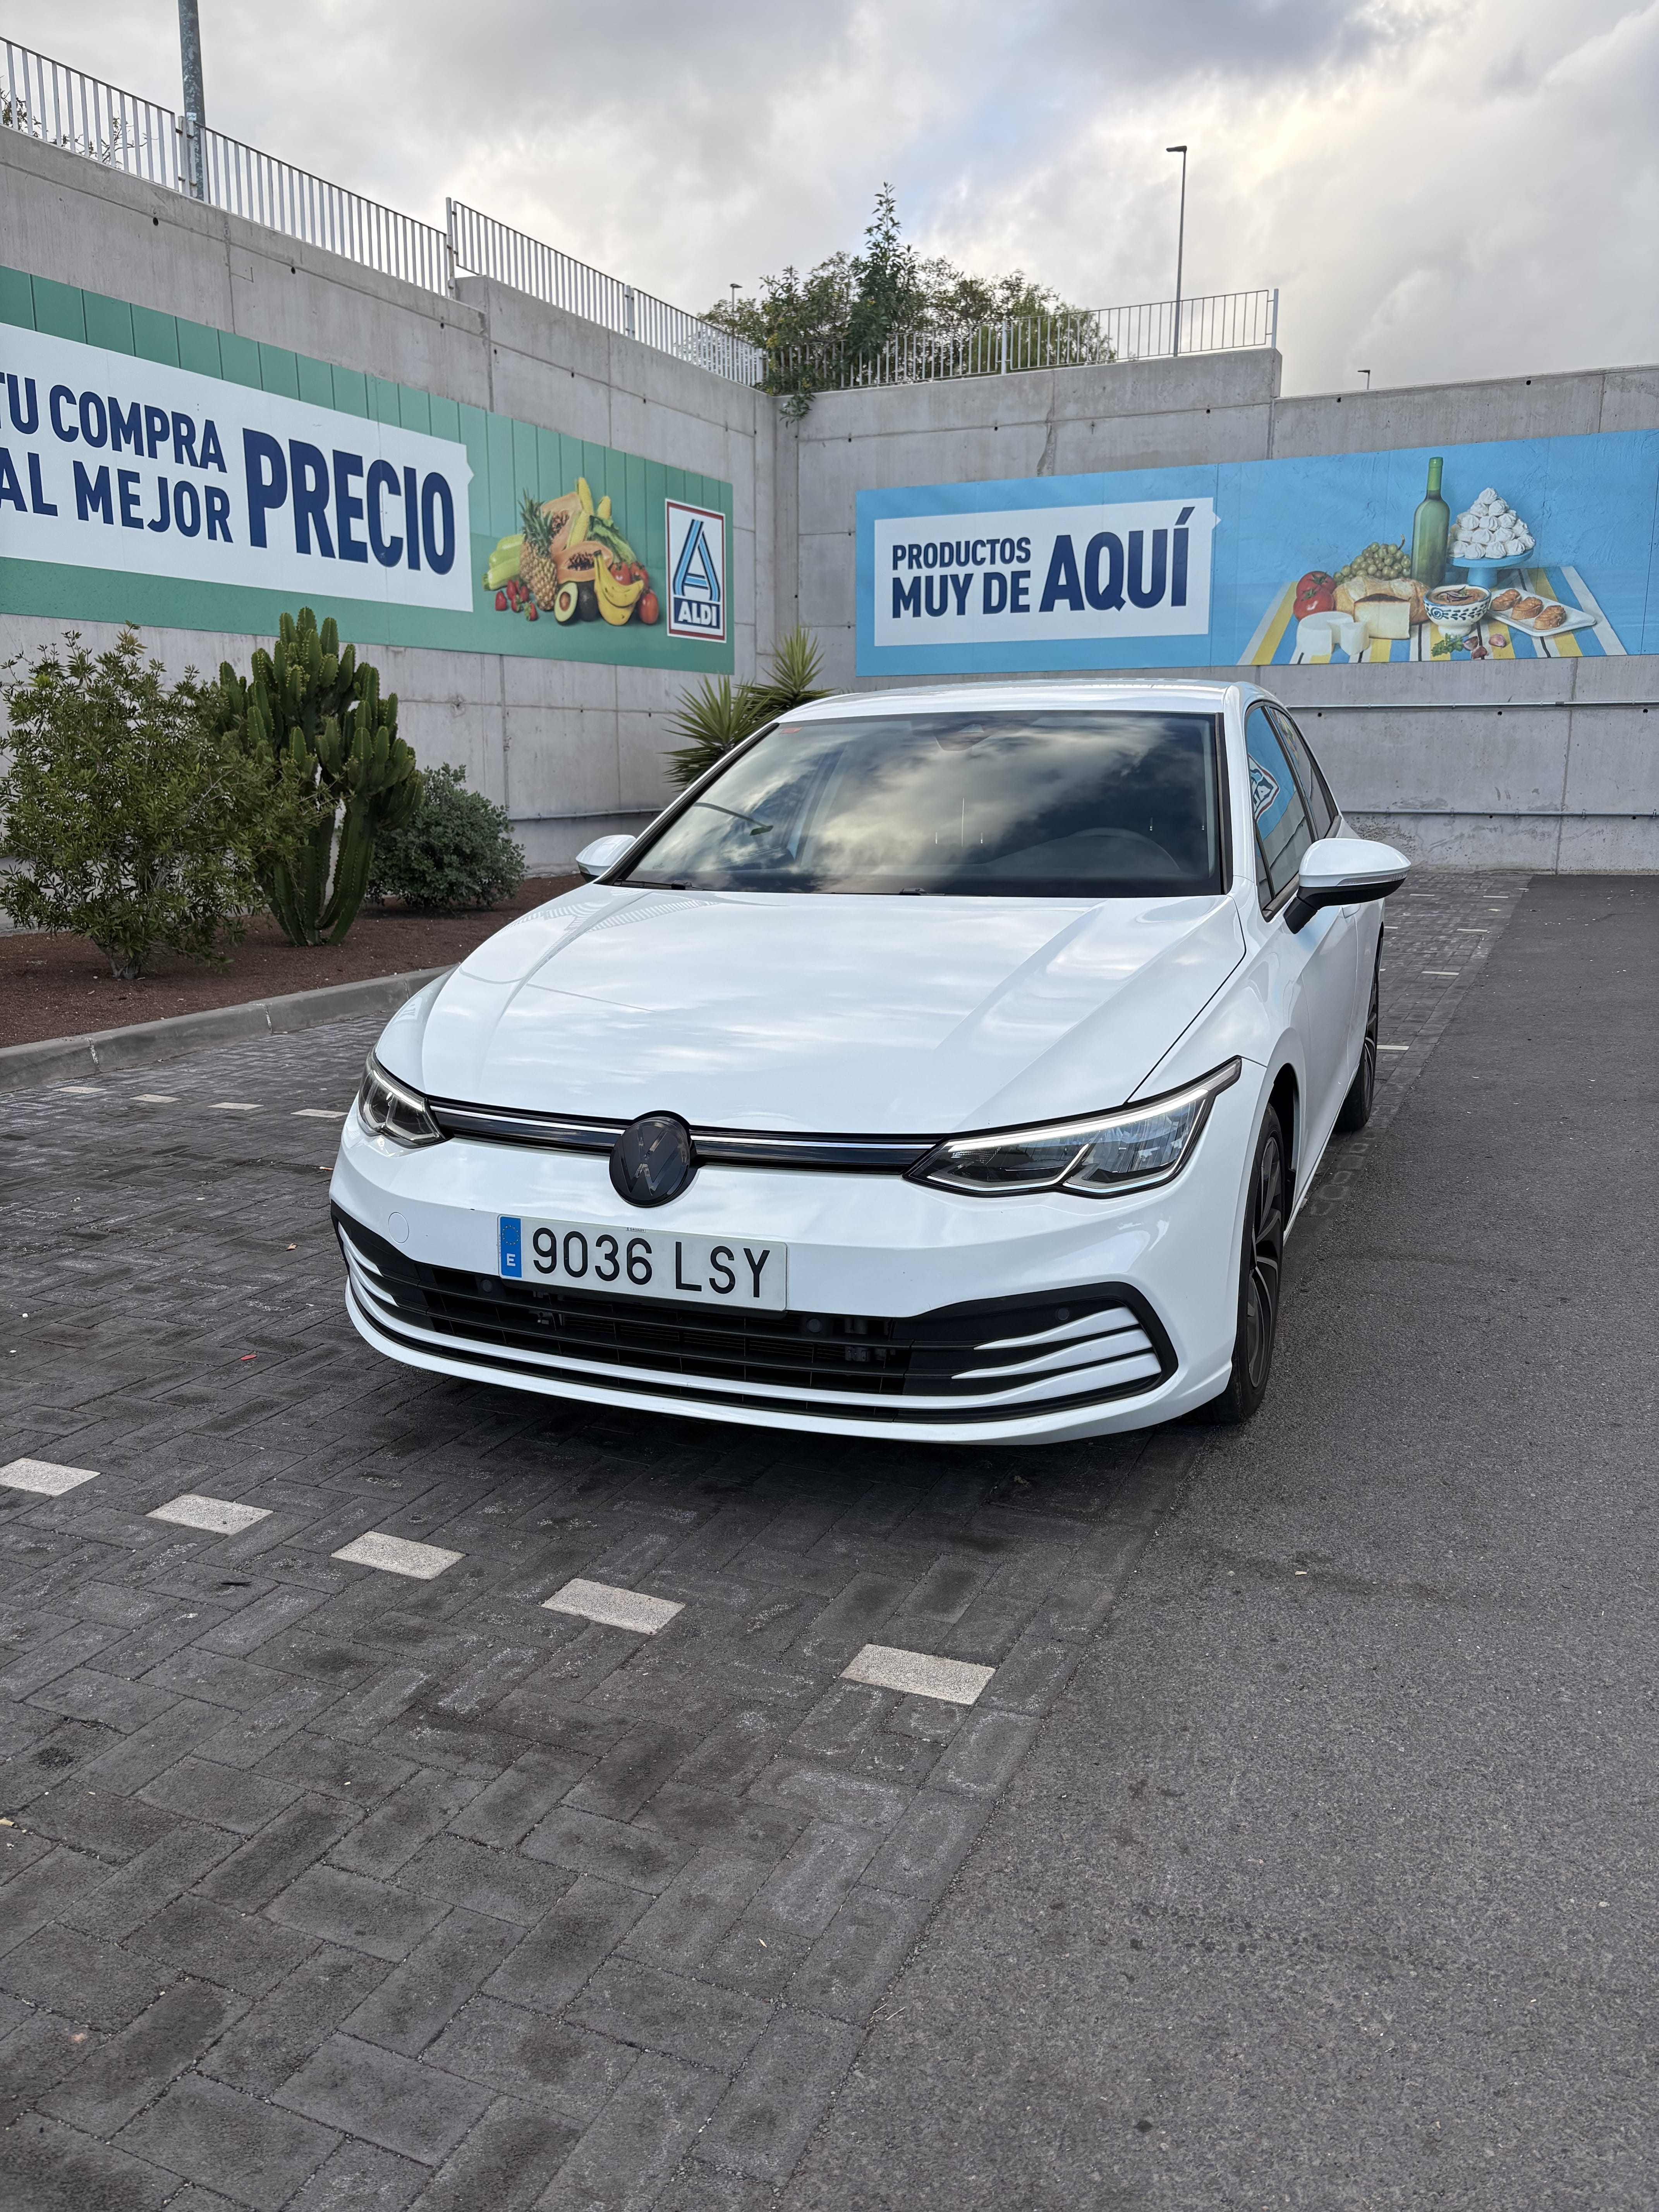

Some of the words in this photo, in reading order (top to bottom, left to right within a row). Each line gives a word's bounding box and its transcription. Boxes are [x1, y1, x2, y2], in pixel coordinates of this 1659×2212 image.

[0, 372, 39, 434] U
[50, 385, 227, 473] COMPRA
[0, 447, 58, 516] AL
[73, 460, 233, 543] MEJOR
[242, 428, 455, 575] PRECIO
[893, 537, 1030, 570] PRODUCTOS
[893, 573, 974, 618] MUY
[983, 570, 1030, 614] DE
[1039, 507, 1195, 612] AQUÍ
[678, 601, 716, 626] ALDI
[507, 1254, 515, 1266] E
[533, 1228, 652, 1285] 9036
[676, 1242, 770, 1298] LSY
